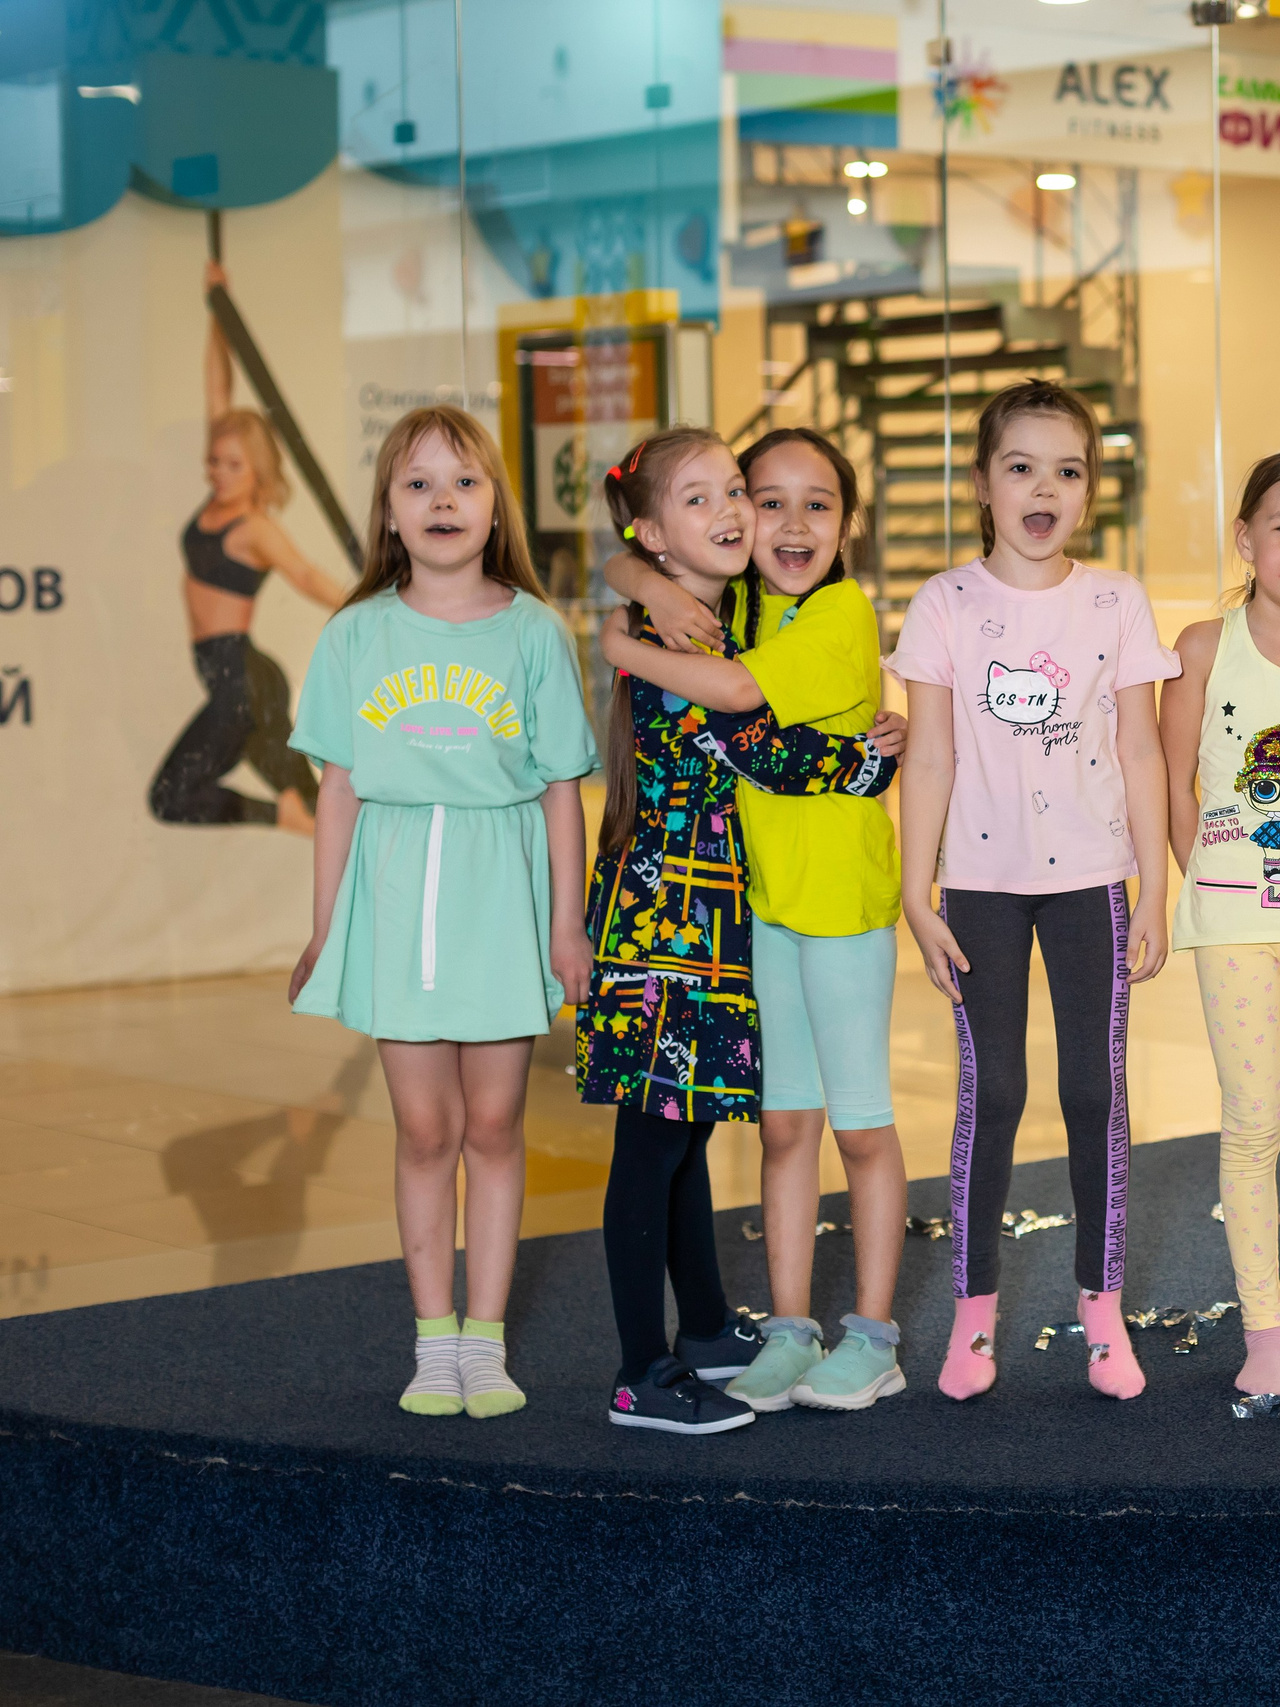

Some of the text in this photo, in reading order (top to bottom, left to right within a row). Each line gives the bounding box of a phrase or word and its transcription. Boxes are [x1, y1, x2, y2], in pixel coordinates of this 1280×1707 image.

[1055, 60, 1171, 111] ALEX
[357, 662, 522, 740] NEVER GIVE UP
[1042, 731, 1079, 756] girls
[1201, 826, 1249, 848] SCHOOL
[1204, 817, 1240, 830] BACK TO
[1116, 935, 1128, 952] ON
[1112, 992, 1127, 1064] HAPPINESS
[960, 1064, 974, 1106] LOOKS
[1114, 1065, 1125, 1108] LOOKS
[953, 1105, 974, 1166] FANTASTIC
[1111, 1109, 1127, 1168] FANTASTIC
[951, 1165, 966, 1184] ON
[1111, 1172, 1127, 1187] ON
[1111, 1187, 1127, 1209] YOU
[1107, 1220, 1125, 1281] HAPPINESS
